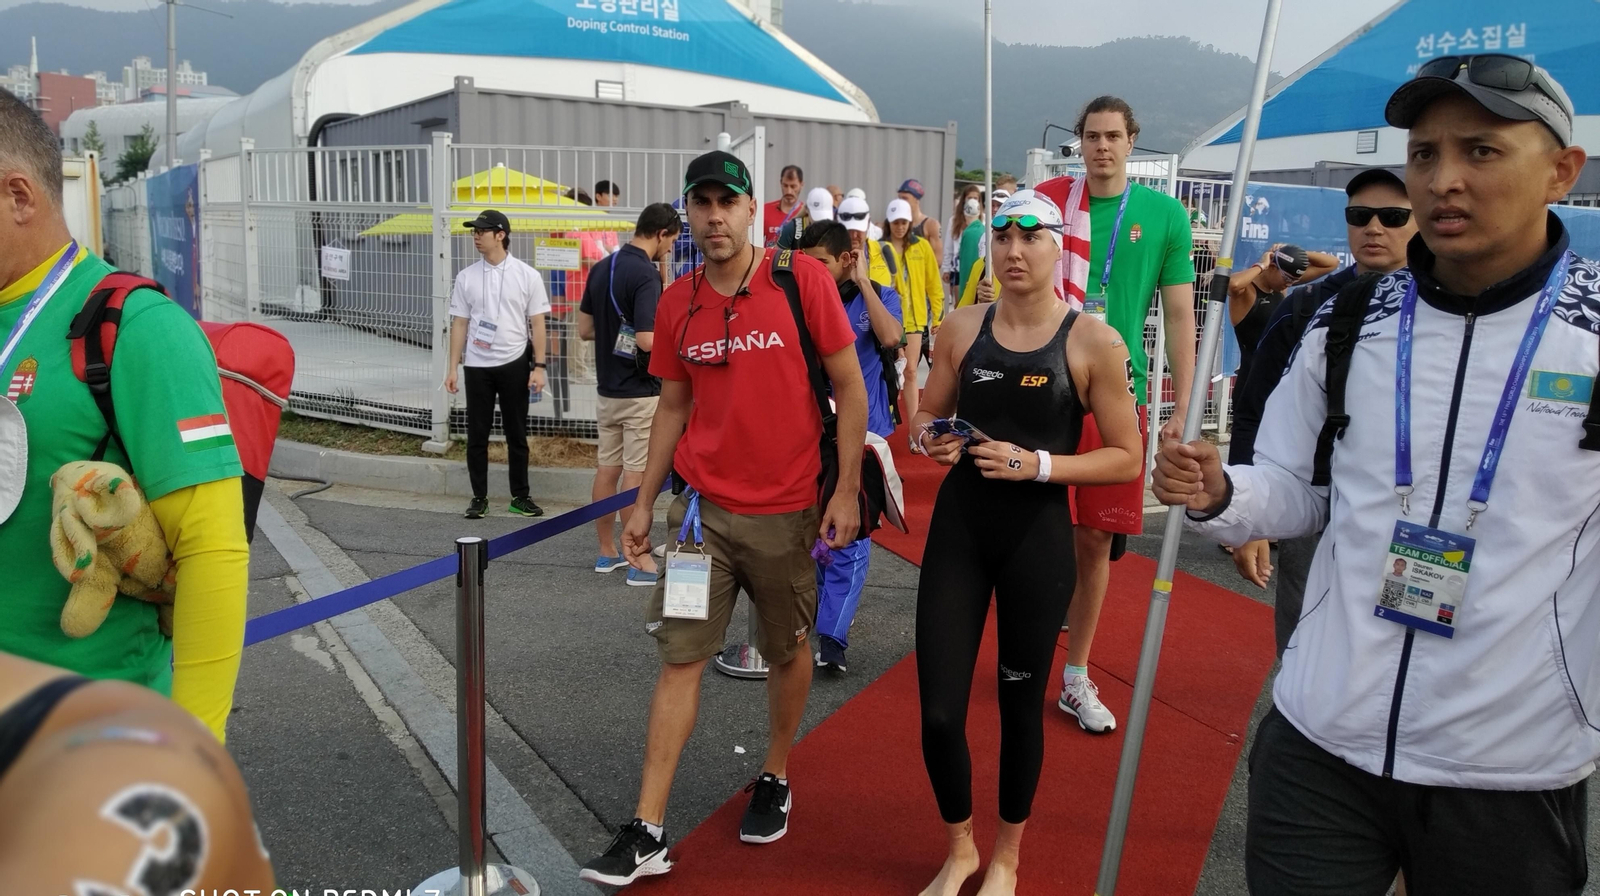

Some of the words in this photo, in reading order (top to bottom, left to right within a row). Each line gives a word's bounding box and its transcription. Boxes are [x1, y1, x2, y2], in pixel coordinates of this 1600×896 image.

[567, 17, 607, 33] Doping
[609, 20, 650, 35] Control
[652, 25, 690, 41] Station
[1415, 22, 1527, 58] 선수소집실
[687, 330, 785, 360] ESPAÑA
[973, 368, 1004, 379] speedo
[1020, 376, 1048, 387] ESP
[1394, 544, 1420, 558] TEAM
[1422, 552, 1465, 571] OFFICIAL
[1412, 567, 1445, 580] ISKAKOV
[1413, 562, 1433, 572] Dauren
